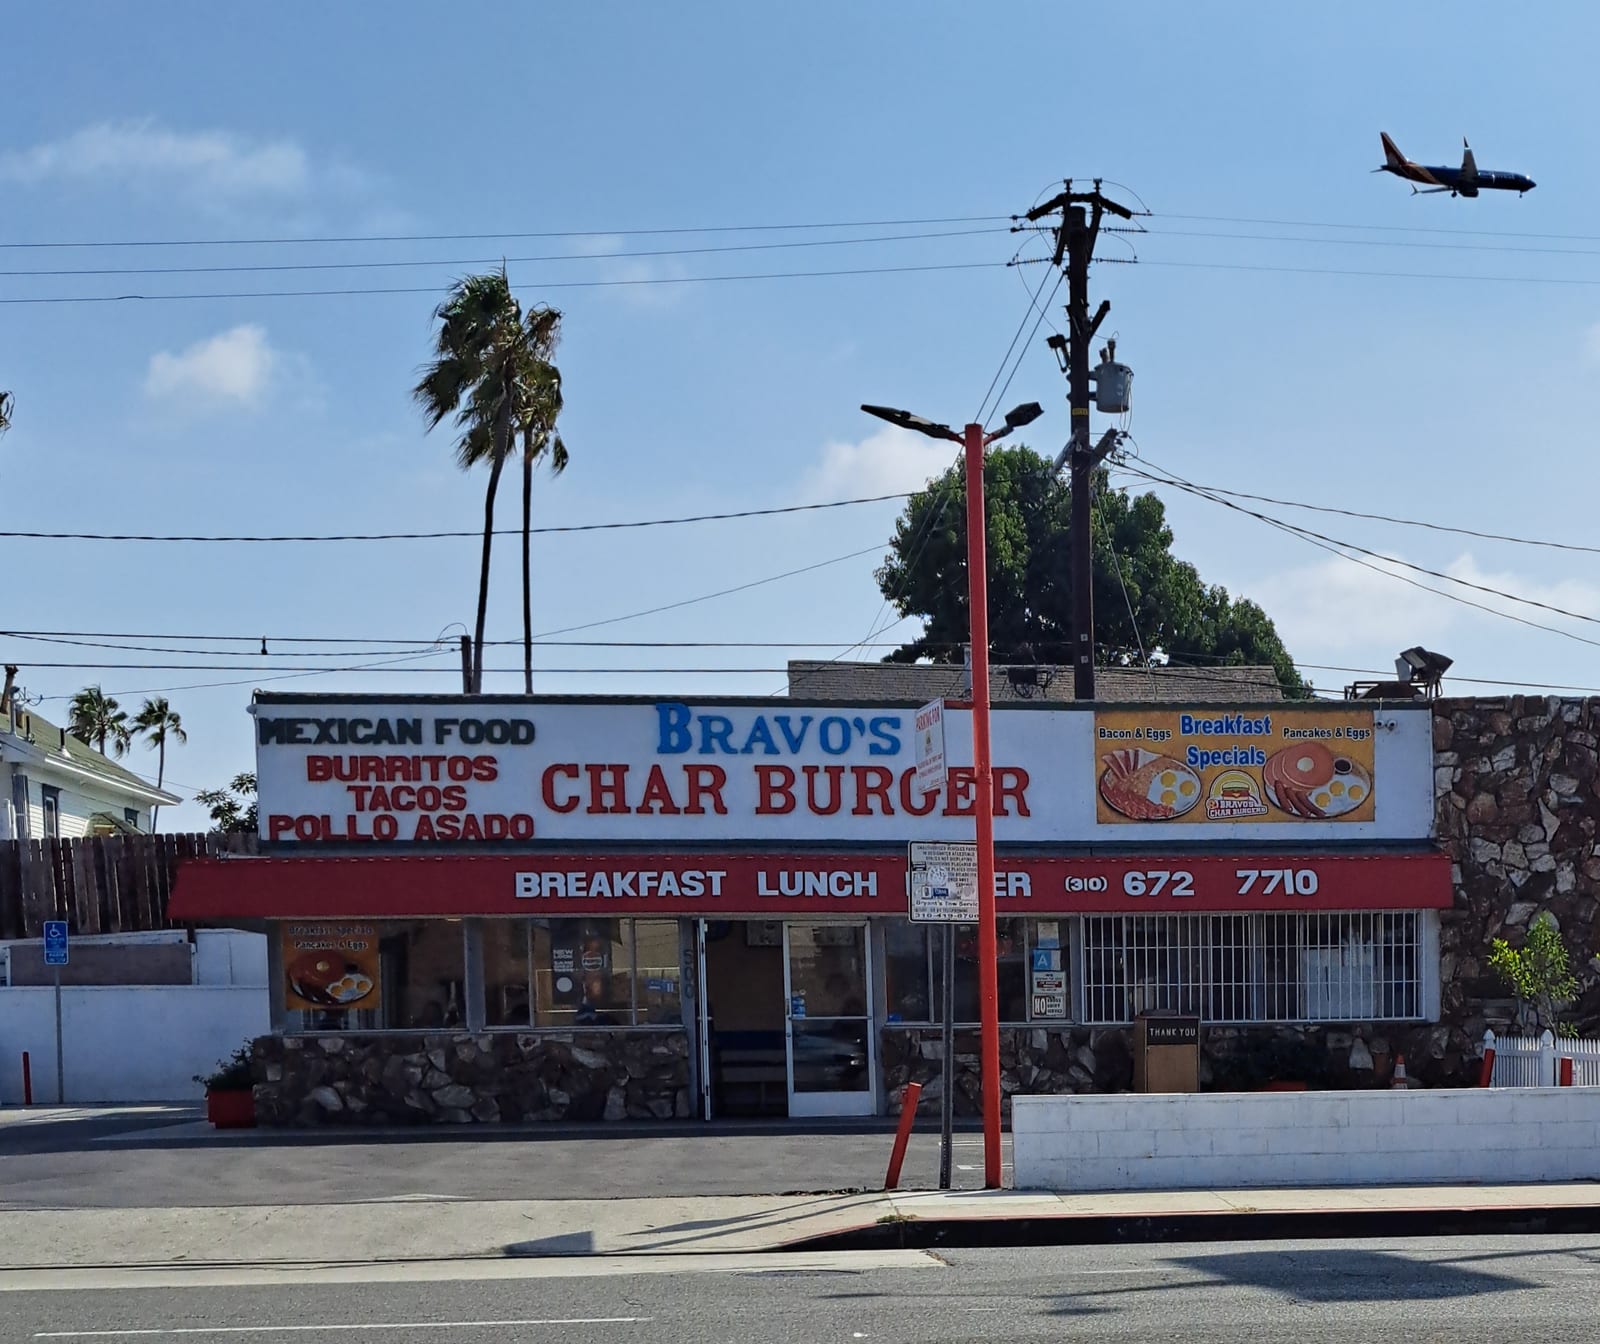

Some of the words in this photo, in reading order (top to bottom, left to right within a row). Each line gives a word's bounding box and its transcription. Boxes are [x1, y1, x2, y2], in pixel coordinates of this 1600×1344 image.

[259, 716, 423, 746] MEXICAN
[434, 717, 536, 746] FOOD
[655, 702, 902, 757] BRAVO'S
[1099, 727, 1132, 739] Bacon
[1135, 727, 1143, 739] &
[1146, 727, 1172, 741] Eggs
[1180, 714, 1271, 735] Breakfast
[1283, 727, 1333, 738] Pancakes
[1335, 727, 1343, 738] &
[1346, 726, 1371, 740] Eggs
[307, 756, 497, 782] BURRITOS
[1186, 746, 1266, 771] Specials
[348, 786, 467, 812] TACOS
[541, 765, 728, 815] CHAR
[755, 765, 1030, 817] BURGER
[269, 815, 397, 841] POLLO
[415, 815, 534, 841] ASADO
[515, 870, 727, 898] BREAKFAST
[757, 871, 877, 898] LUNCH
[1065, 875, 1107, 892] (310)
[1123, 871, 1195, 896] 672
[1236, 869, 1319, 896] 7710
[1037, 954, 1048, 967] A
[1150, 1028, 1177, 1036] THANK
[1179, 1028, 1196, 1037] YOU
